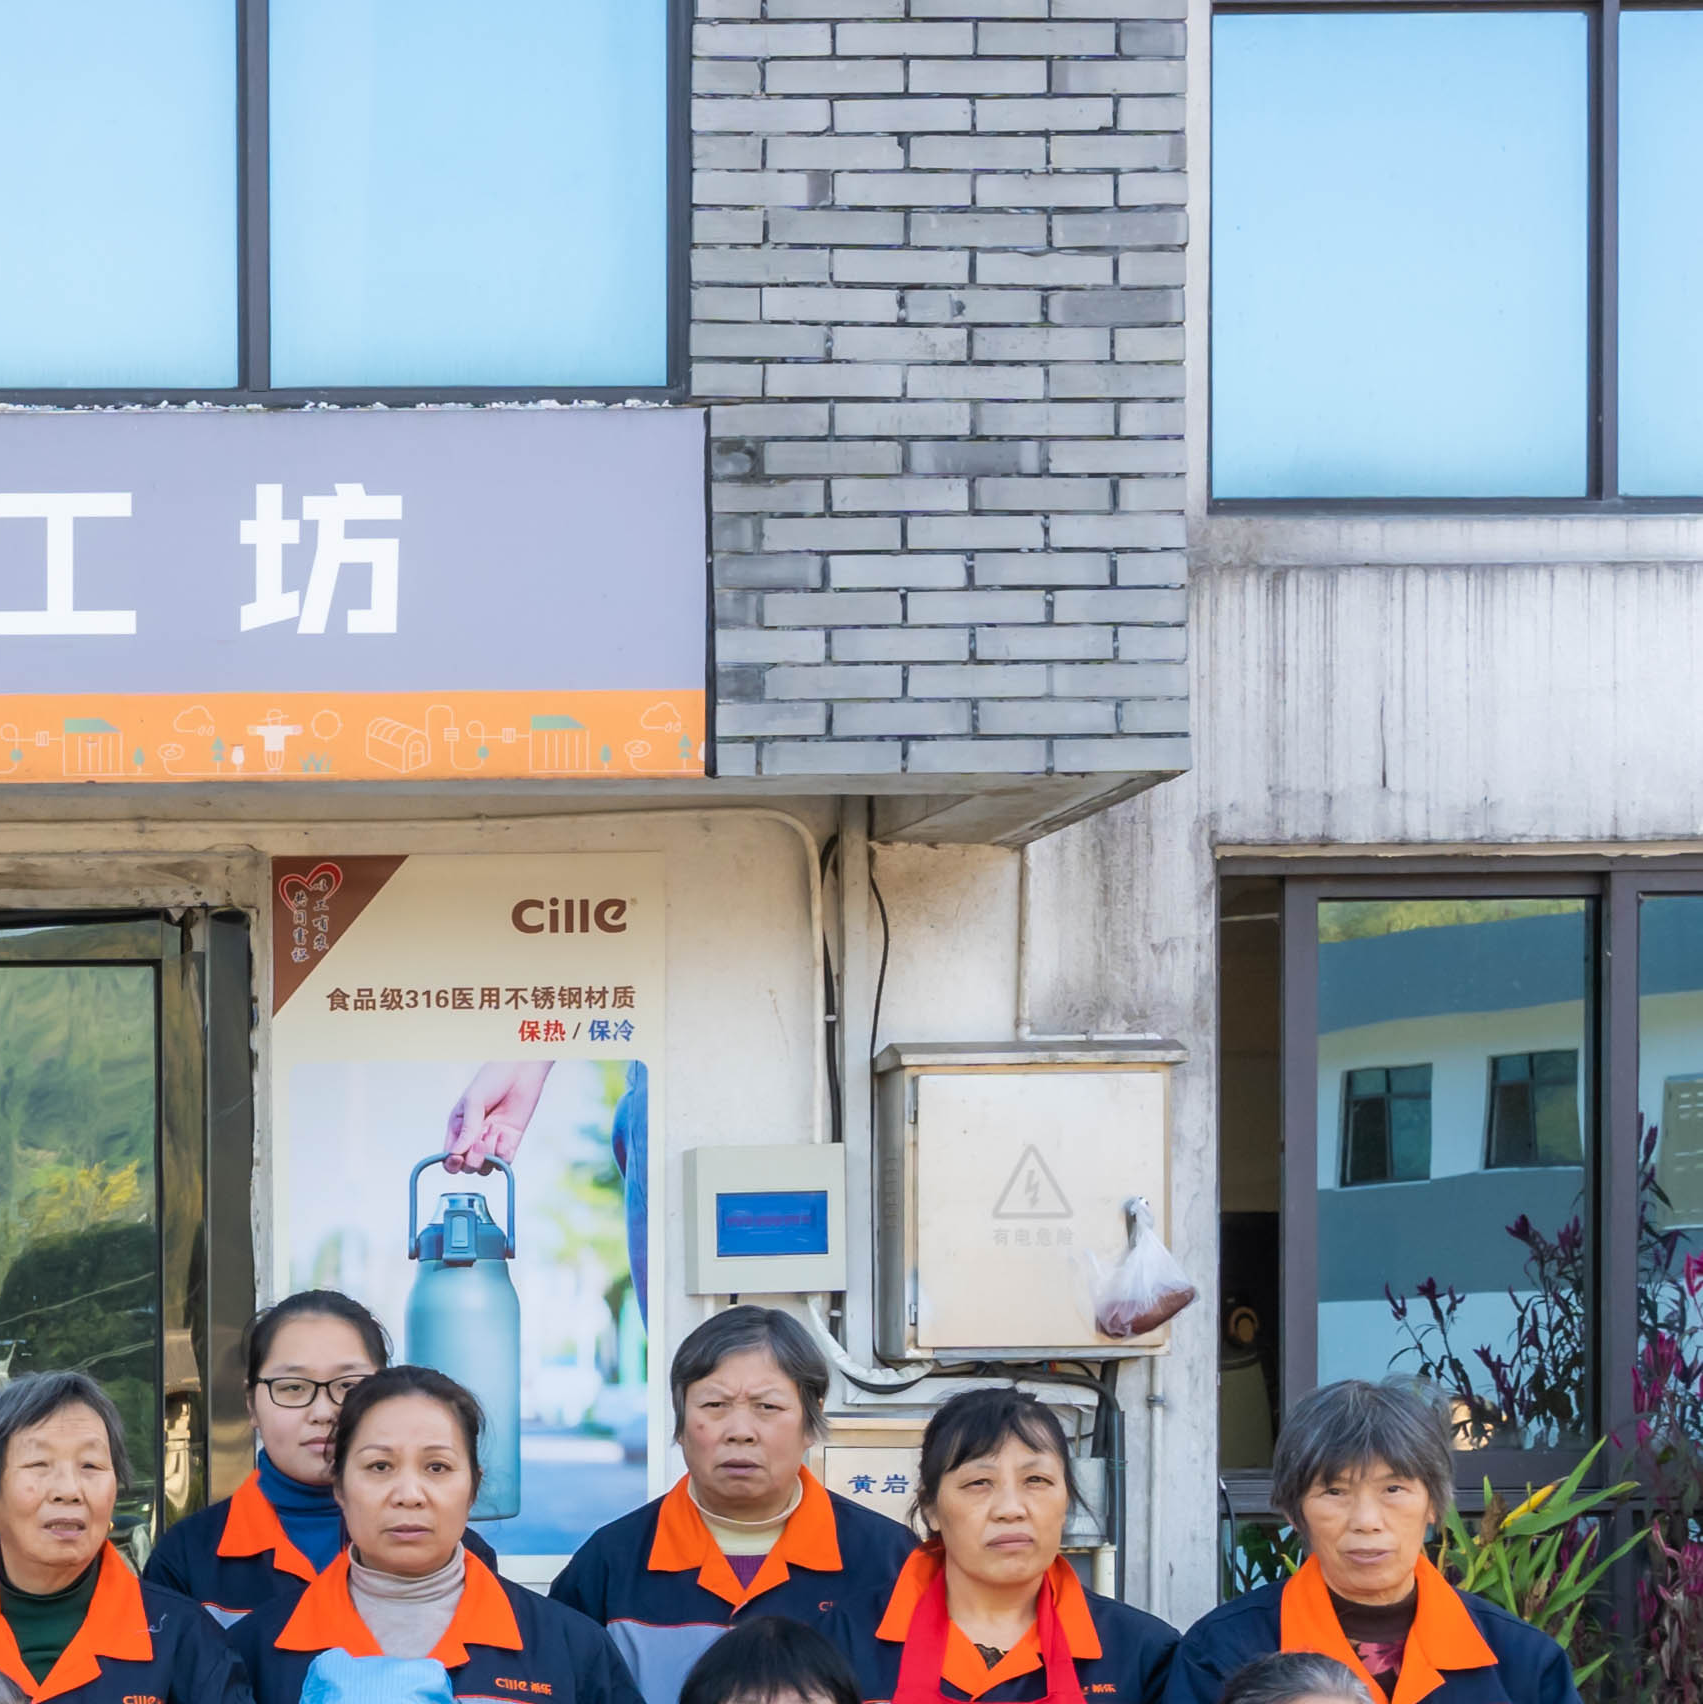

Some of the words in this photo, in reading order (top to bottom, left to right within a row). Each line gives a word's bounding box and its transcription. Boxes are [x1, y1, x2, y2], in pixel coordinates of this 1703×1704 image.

[326, 986, 636, 1011] 食品级316医用不锈钢材质
[993, 1226, 1073, 1247] 有电危险
